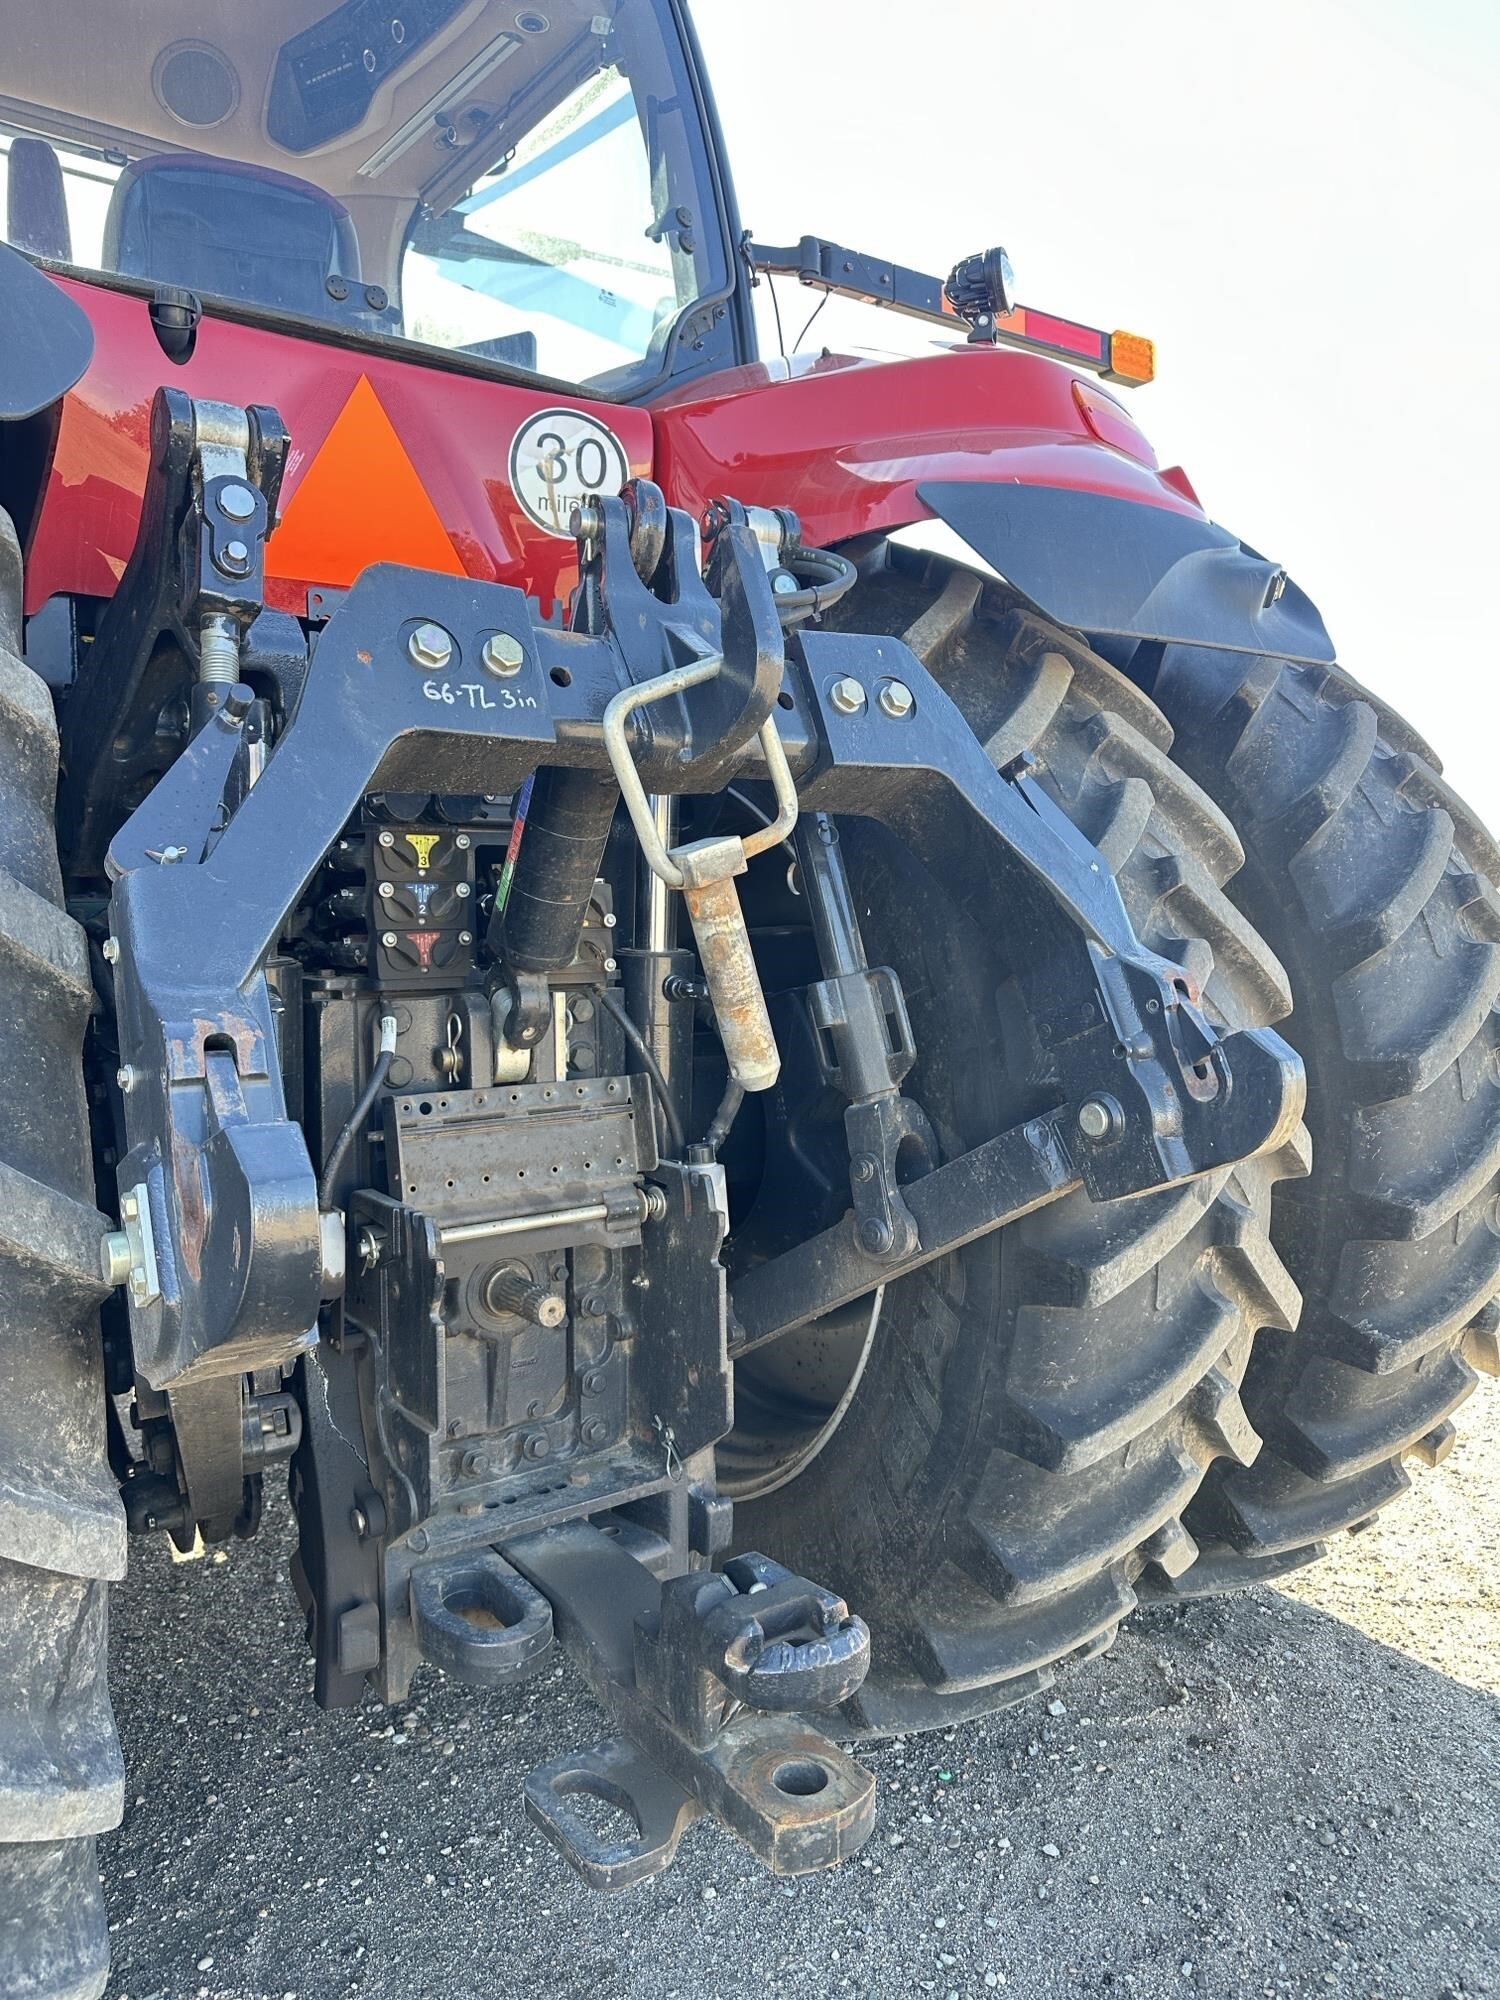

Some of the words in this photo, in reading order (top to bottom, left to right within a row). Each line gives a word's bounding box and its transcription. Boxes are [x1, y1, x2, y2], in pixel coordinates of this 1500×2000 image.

[536, 432, 607, 489] 30
[538, 495, 581, 513] mile
[420, 856, 427, 866] 3
[419, 904, 427, 915] 2
